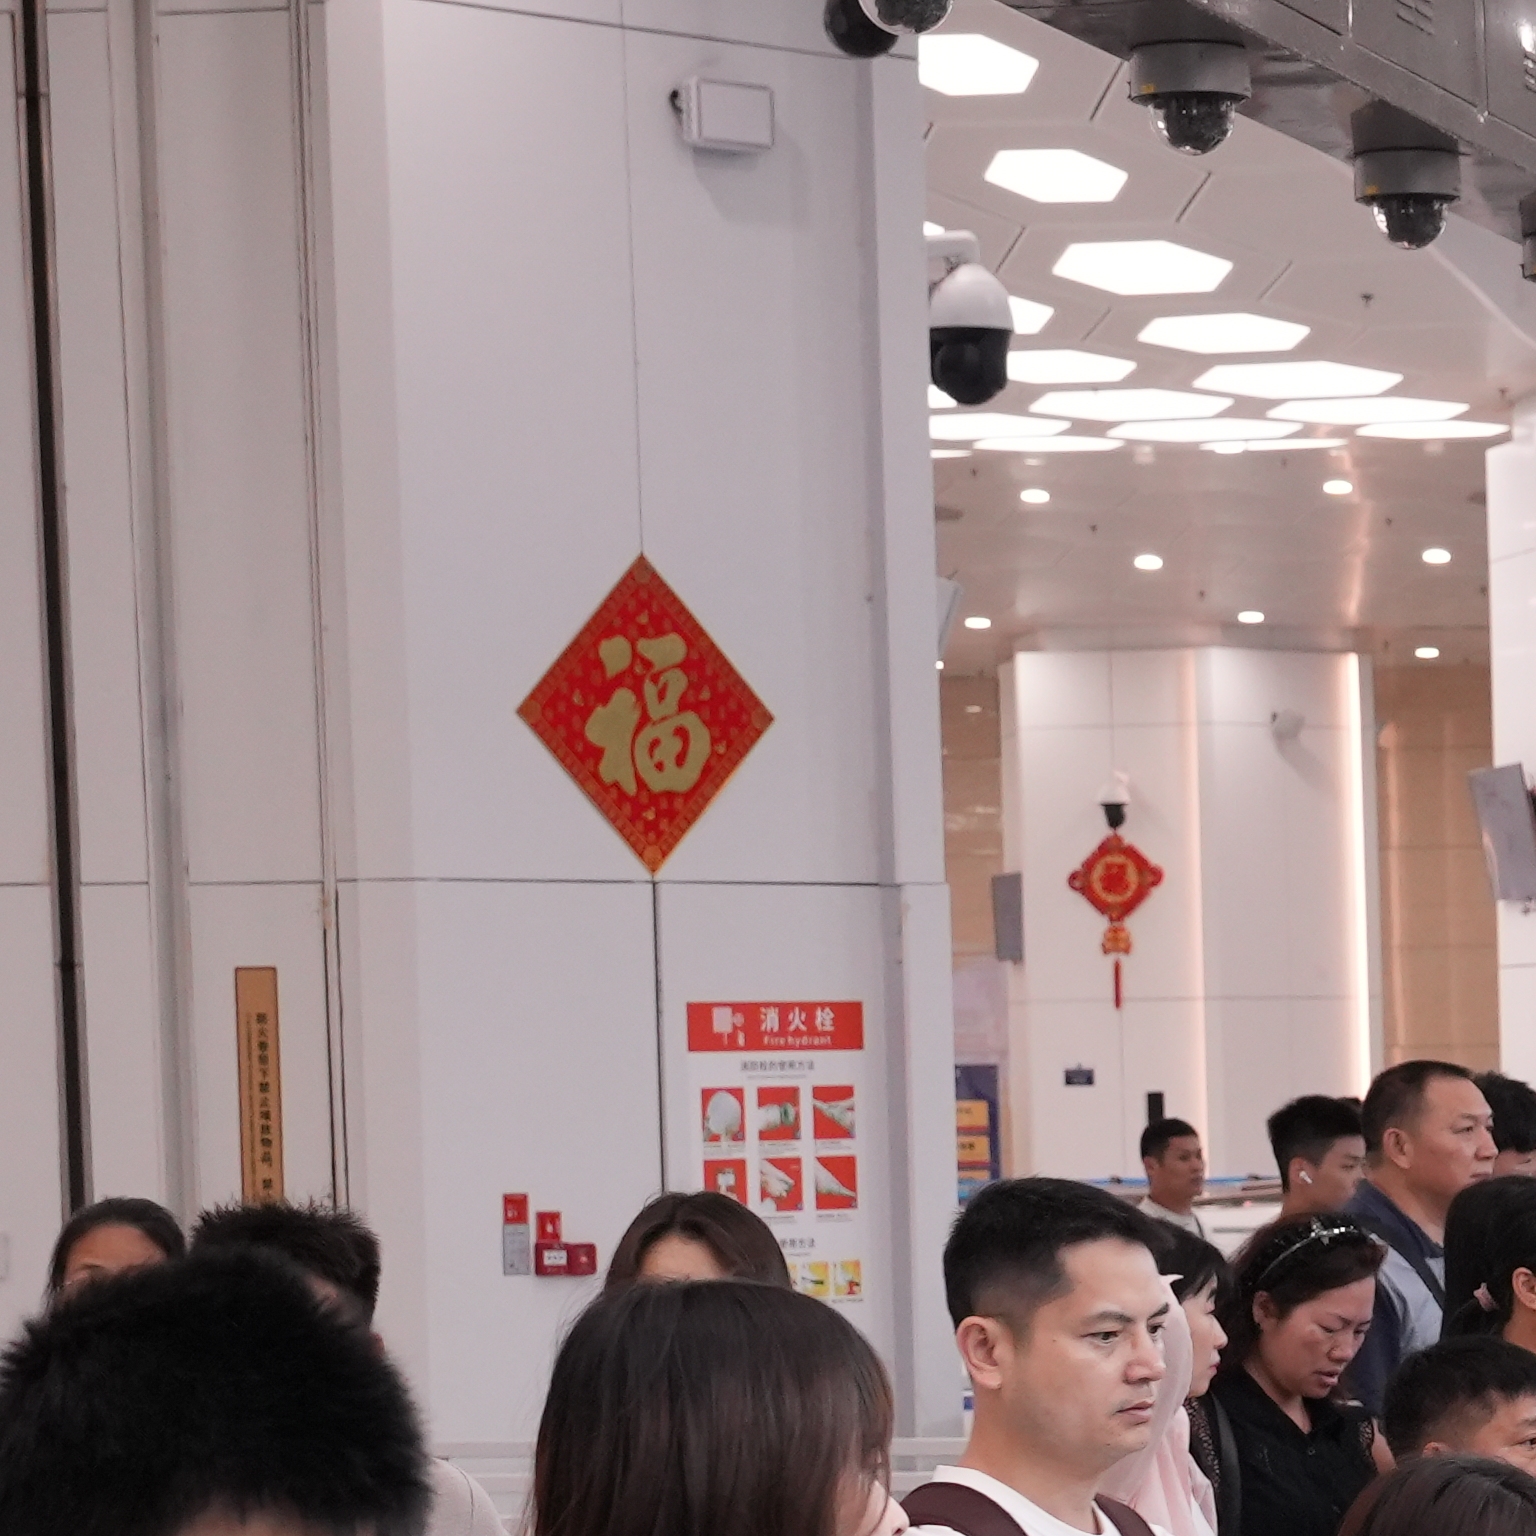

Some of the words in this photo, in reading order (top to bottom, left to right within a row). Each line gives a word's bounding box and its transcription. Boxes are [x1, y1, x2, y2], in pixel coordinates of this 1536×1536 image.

[584, 632, 711, 797] 福
[759, 1005, 836, 1033] 消火栓
